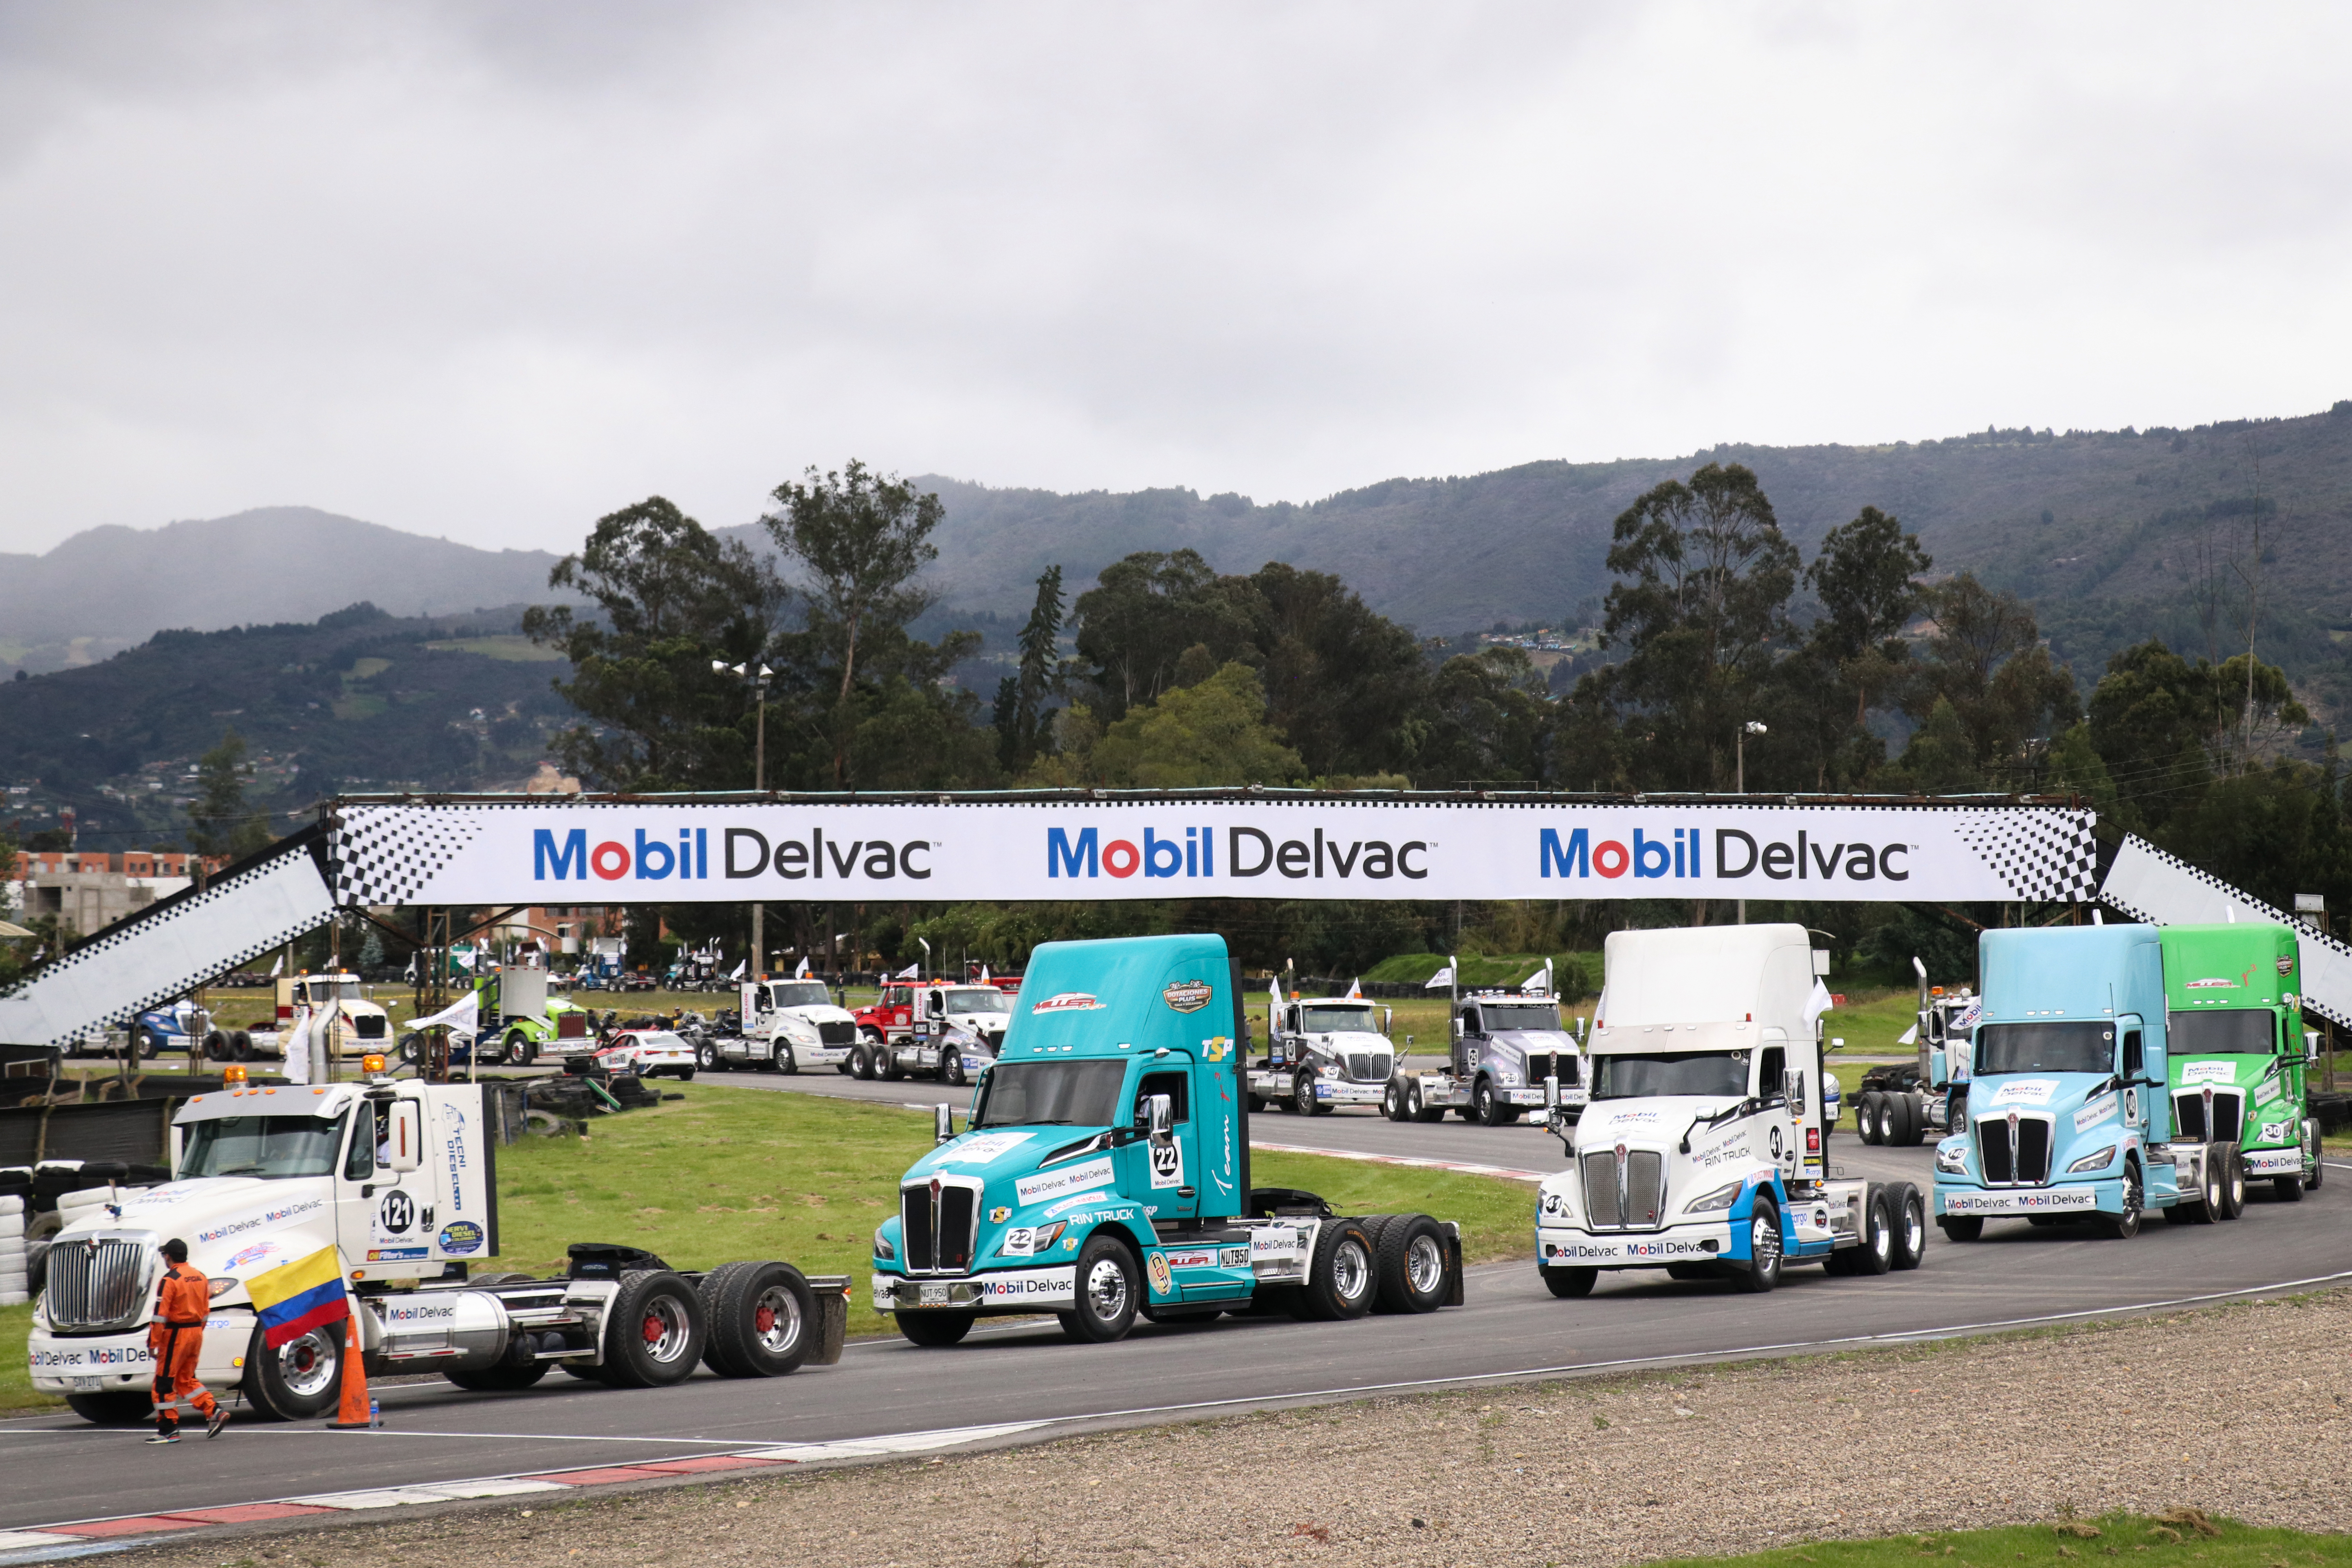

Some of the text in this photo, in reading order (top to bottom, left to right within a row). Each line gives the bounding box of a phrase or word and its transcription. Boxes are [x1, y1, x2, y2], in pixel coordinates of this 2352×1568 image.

[534, 828, 707, 880] Mobil
[1047, 827, 1214, 878] Mobil
[1540, 828, 1701, 878] Mobil
[1167, 989, 1208, 998] DOTACIONES
[1959, 1004, 1982, 1027] Mobil
[1201, 1036, 1234, 1062] TSP
[1470, 1052, 1477, 1064] 25
[2076, 1112, 2098, 1126] Mobil Delvac
[2266, 1126, 2280, 1135] 30
[961, 1140, 1007, 1148] Mobil
[1723, 1129, 1747, 1148] Mobil Delvac
[1771, 1131, 1782, 1154] 41
[453, 1128, 466, 1168] TECNI
[951, 1146, 1003, 1155] Delvac
[1692, 1145, 1722, 1164] Mobil Delvac
[1949, 1149, 1965, 1159] 149
[1156, 1146, 1176, 1171] 22
[1705, 1146, 1751, 1168] RIN TRUCK
[2252, 1159, 2279, 1169] Mobil
[1069, 1168, 1111, 1184] Mobil Delvac
[141, 1189, 191, 1197] Mobil
[1020, 1179, 1065, 1196] Mobil Delvac
[125, 1196, 183, 1206] Delvac
[1056, 1201, 1076, 1211] PLAST
[1545, 1196, 1562, 1210] 41
[1948, 1198, 2011, 1209] Mobil Delvac
[2019, 1194, 2090, 1207] Mobil Delvac
[266, 1199, 323, 1222] Mobil Delvac
[382, 1198, 411, 1226] 121
[989, 1206, 1012, 1223] TSP
[1068, 1208, 1134, 1226] RIN TRUCK
[200, 1218, 262, 1243] Mobil Delvac
[445, 1225, 468, 1233] SERVI
[1009, 1232, 1031, 1245] 22
[1063, 1237, 1078, 1251] TSP
[1254, 1239, 1295, 1251] Mobil Delvac
[1555, 1245, 1618, 1258] obil Delvac
[1627, 1241, 1703, 1255] Mobil Delva
[1221, 1249, 1249, 1265] NUT950
[983, 1278, 1073, 1296] Mobil Delvac
[390, 1305, 455, 1321] Mobil Delvac
[207, 1320, 230, 1328] argo
[29, 1351, 83, 1366] obil Delvac
[89, 1348, 123, 1364] Mobil
